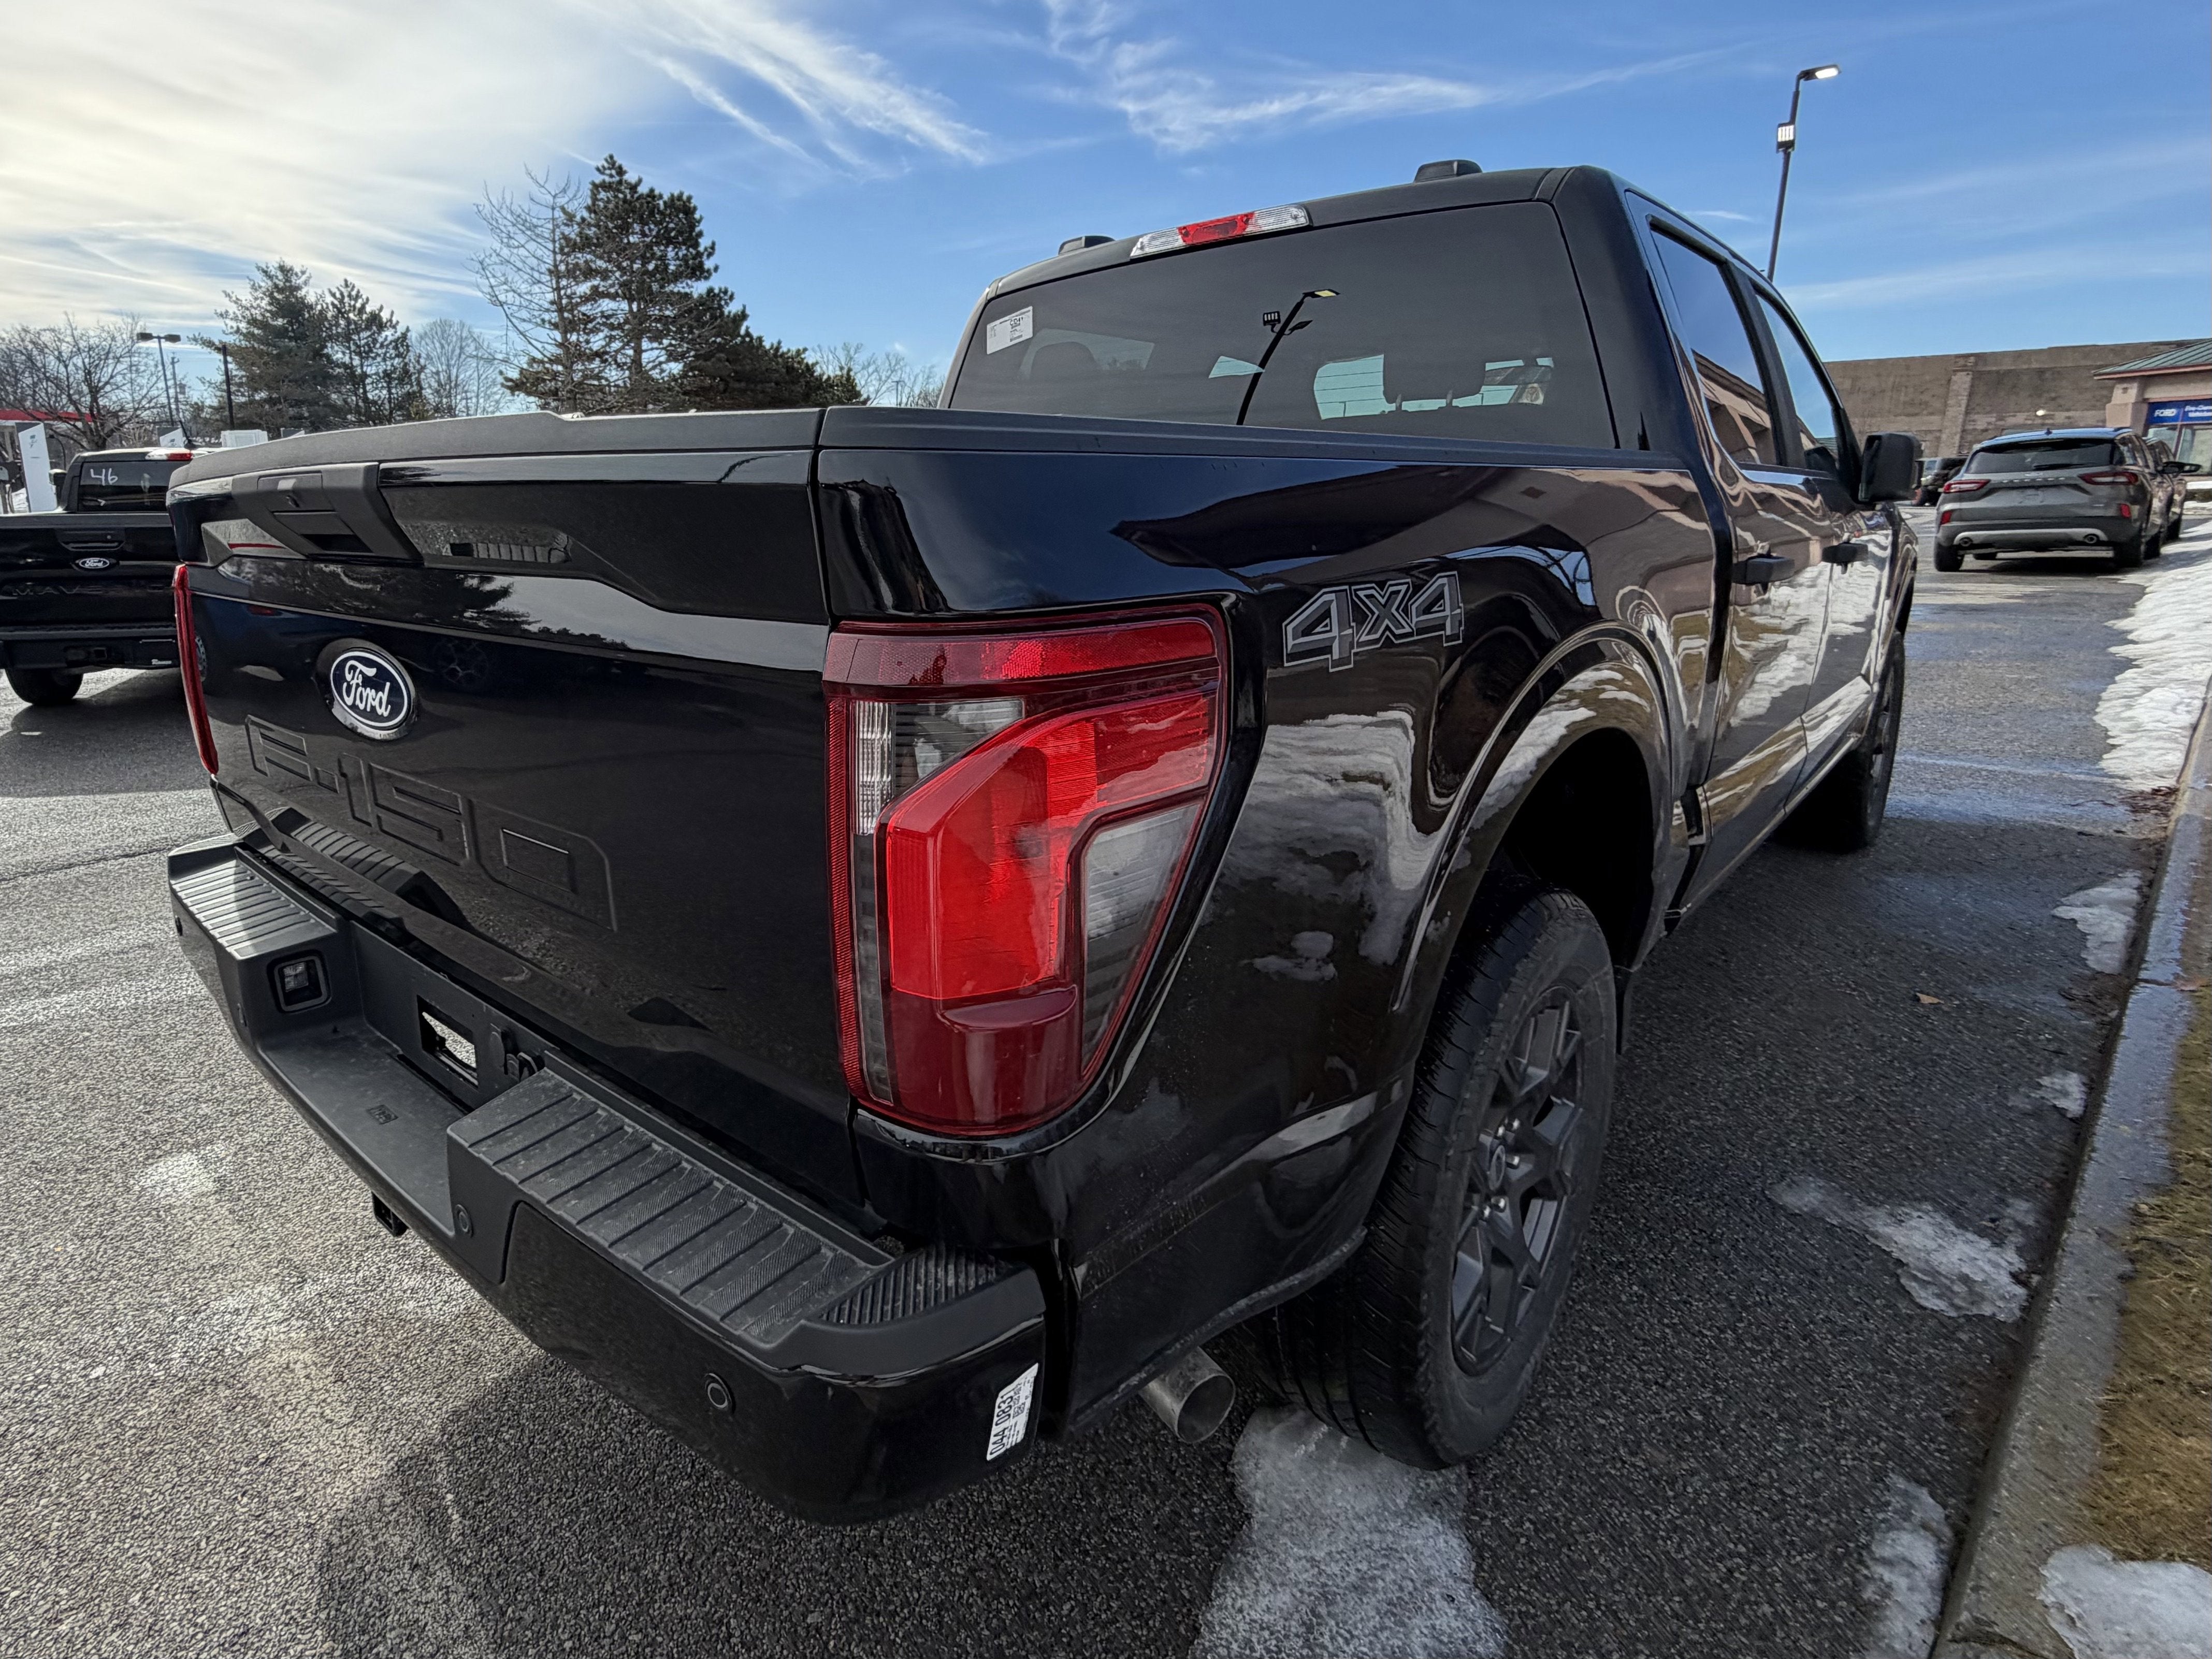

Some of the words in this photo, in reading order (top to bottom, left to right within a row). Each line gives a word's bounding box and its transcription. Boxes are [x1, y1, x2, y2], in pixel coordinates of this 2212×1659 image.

[90, 468, 118, 486] 46
[342, 660, 391, 717] Ford
[245, 714, 620, 933] F-150
[995, 1387, 1018, 1426] 0831
[989, 1425, 1009, 1455] 044
